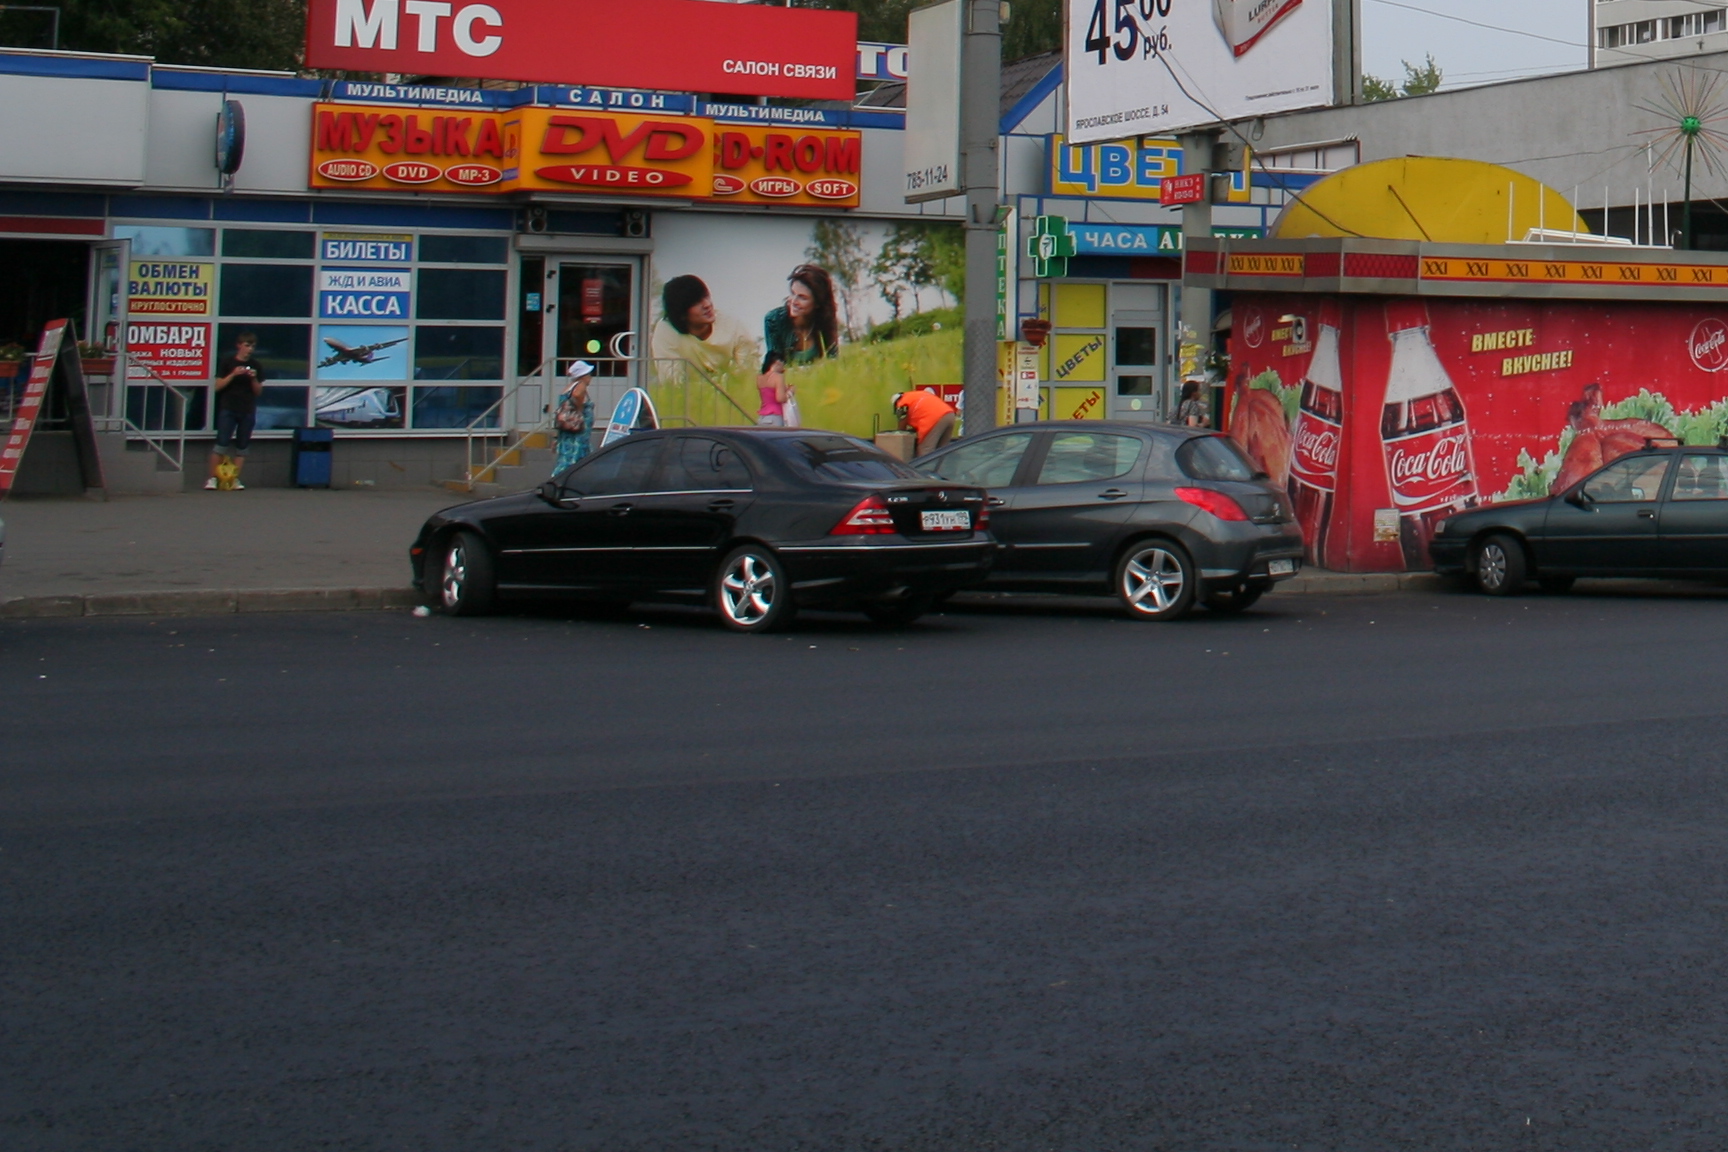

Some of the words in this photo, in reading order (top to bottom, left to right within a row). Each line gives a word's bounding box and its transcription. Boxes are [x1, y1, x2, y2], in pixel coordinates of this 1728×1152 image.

[1143, 25, 1172, 61] руб.
[723, 59, 779, 77] САЛОН
[783, 63, 836, 80] СВЯЗИ
[347, 83, 483, 103] МУЛЬТИМЕДИА
[569, 89, 665, 109] САЛОН
[706, 103, 825, 123] МУЛЬТИМЕДИА
[317, 110, 504, 158] МУЗЫКА
[540, 115, 705, 164] DVD
[327, 162, 356, 176] AUDIO
[357, 164, 372, 177] CD
[398, 165, 428, 179] DVD
[458, 168, 490, 182] MP-3
[570, 167, 664, 184] VIDEO
[1059, 143, 1244, 192] ЦВЕТ
[759, 181, 794, 194] ИГРЫ
[814, 183, 848, 195] SOFT
[327, 241, 406, 259] БИЛЕТЫ
[1085, 232, 1147, 248] ЧАСА
[138, 264, 199, 279] ОБМЕН
[1424, 261, 1447, 275] XXI
[1466, 262, 1489, 276] XXI
[1506, 263, 1529, 277] XXI
[1545, 264, 1566, 278] XXI
[1581, 265, 1603, 279] XXI
[1619, 266, 1641, 280] XXI
[1656, 267, 1677, 281] XXI
[1692, 268, 1712, 282] XXI
[129, 281, 208, 296] ВАЛЮТЫ
[329, 276, 354, 288] Ж/Д
[358, 276, 366, 286] И
[369, 276, 401, 287] АВИА
[130, 302, 205, 311] КРУГЛОСУТОЧНО
[327, 295, 401, 315] КАССА
[1271, 326, 1294, 341] ВМЕСТ
[1471, 328, 1533, 352] ВМЕСТЕ
[160, 349, 203, 357] НОВЫХ
[1056, 336, 1103, 378] ЦВЕТЫ
[1502, 350, 1573, 376] ВКУСНЕЕ!
[1071, 391, 1101, 420] ЕТЫ
[1391, 433, 1469, 486] Coca-Cola
